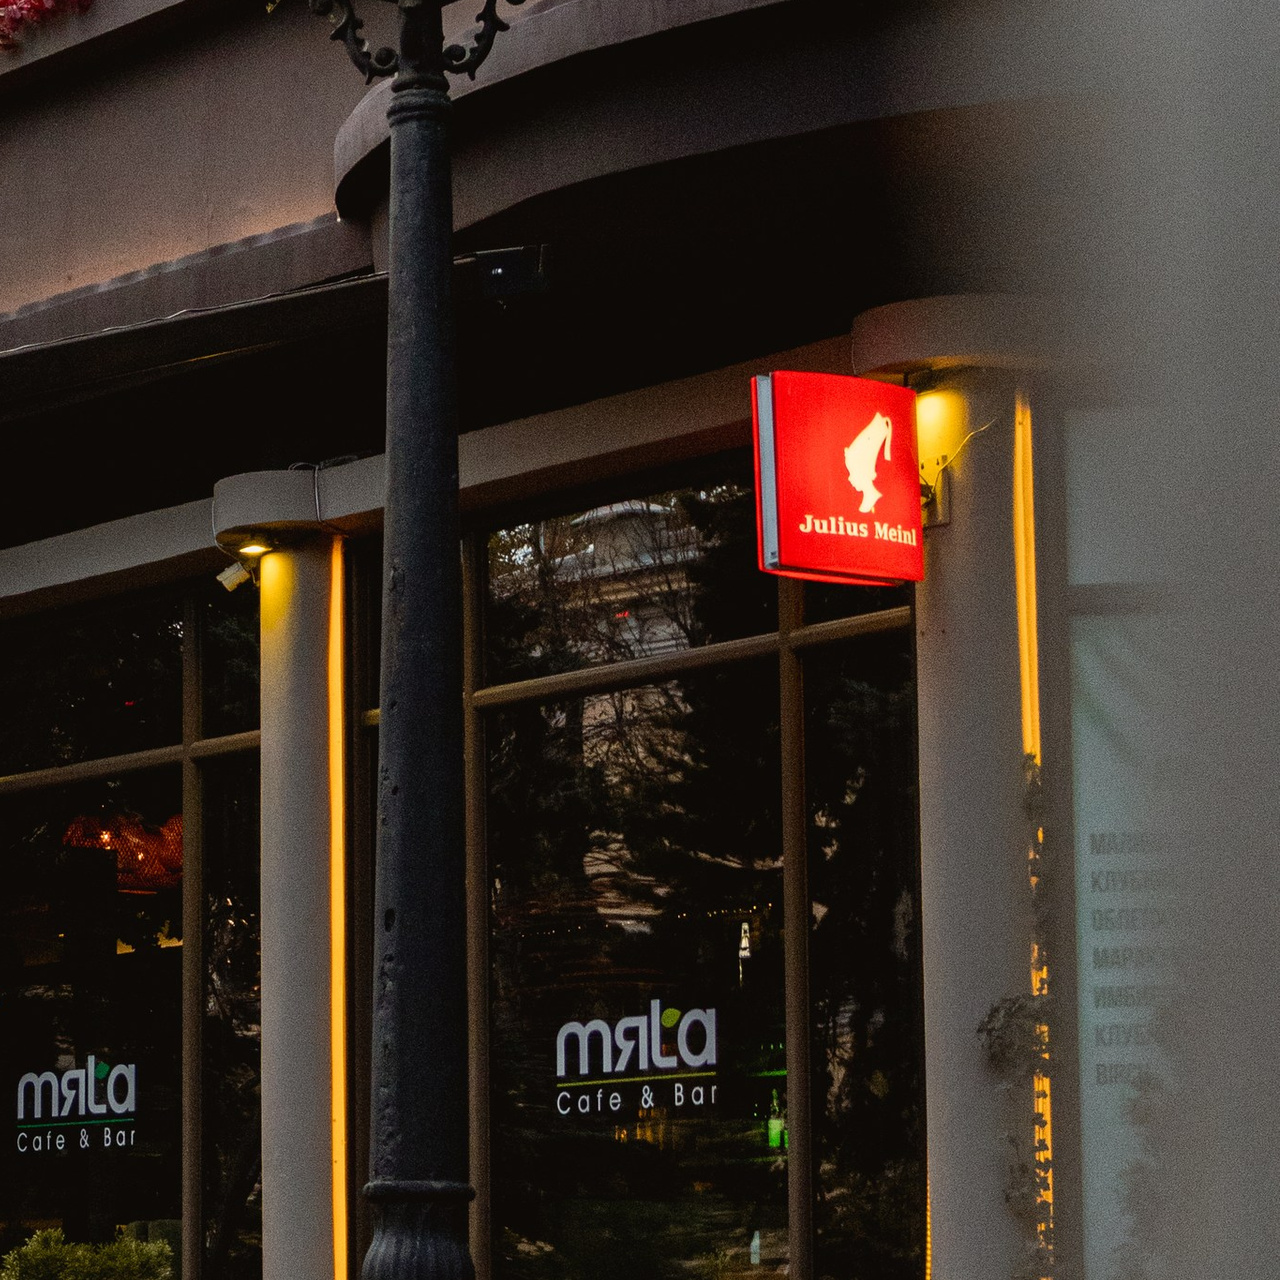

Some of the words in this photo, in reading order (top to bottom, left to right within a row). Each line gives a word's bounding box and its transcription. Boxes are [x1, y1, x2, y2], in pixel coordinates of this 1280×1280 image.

[799, 515, 868, 537] Julius
[874, 522, 917, 546] Meinl
[557, 1089, 621, 1115] Cafe
[641, 1085, 654, 1109] &
[674, 1083, 717, 1107] Bar
[17, 1131, 65, 1152] Cafe
[80, 1128, 89, 1149] &
[104, 1127, 135, 1147] Bar
